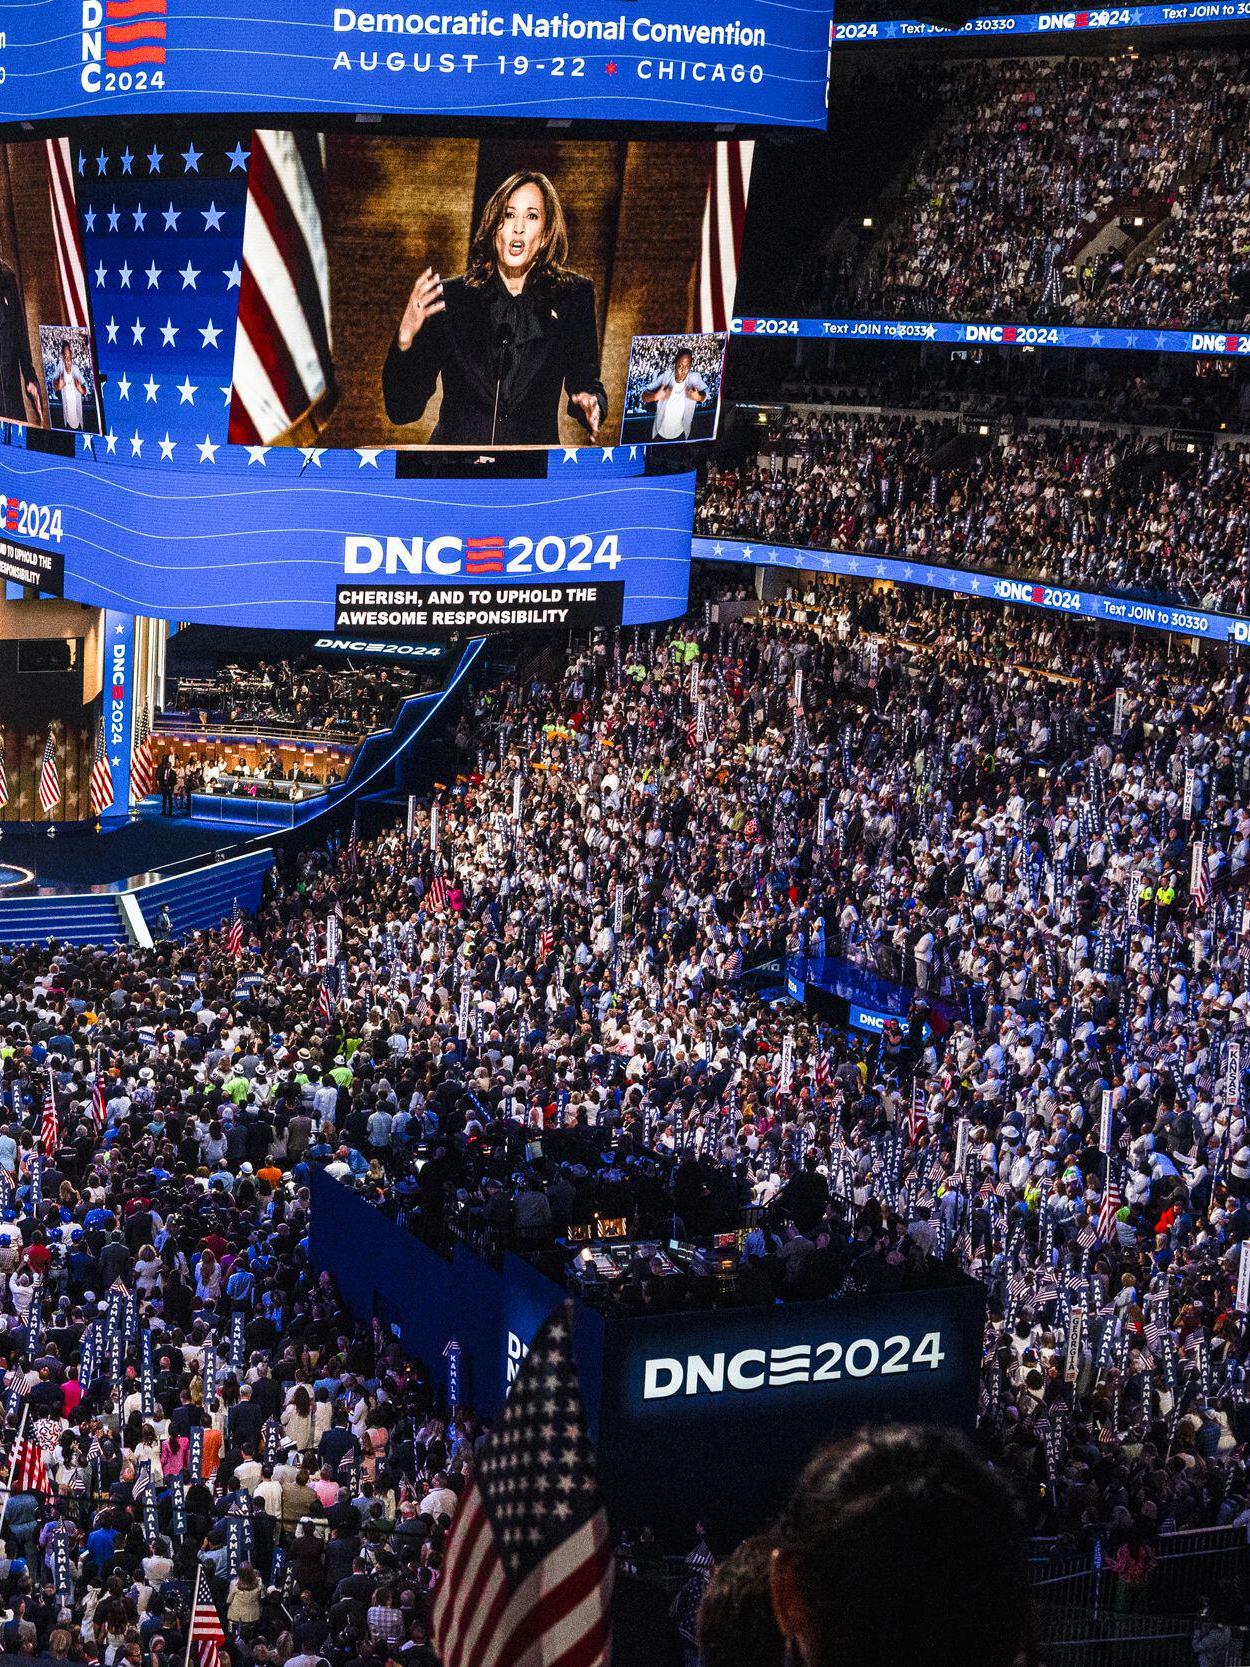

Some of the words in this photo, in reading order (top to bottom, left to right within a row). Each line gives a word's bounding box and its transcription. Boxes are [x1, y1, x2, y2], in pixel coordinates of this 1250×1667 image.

[333, 8, 505, 37] Democratic
[512, 14, 626, 42] National
[633, 18, 766, 47] Convention
[1162, 8, 1187, 20] Text
[1190, 5, 1218, 18] JOIN
[1222, 4, 1234, 16] to
[104, 71, 166, 92] 2024
[333, 51, 479, 74] AUGUST
[497, 55, 586, 78] 19-22
[637, 60, 764, 84] CHICAGO
[823, 323, 849, 335] Text
[851, 324, 881, 336] JOIN
[886, 325, 897, 337] to
[337, 611, 428, 626] AWESOME
[432, 609, 570, 625] RESPONSIBILITY
[338, 590, 423, 608] CHERISH,
[427, 590, 463, 605] AND
[469, 590, 492, 605] TO
[496, 588, 563, 604] UPHOLD
[566, 588, 597, 602] THE
[1103, 600, 1127, 616] Text
[1127, 604, 1155, 622] JOIN
[1158, 609, 1169, 622] to
[1171, 611, 1208, 631] 30330
[1185, 774, 1193, 814] WYOMING
[1129, 877, 1140, 918] NEVADA
[460, 993, 469, 1033] DELAWARE
[1229, 1052, 1237, 1096] KANSAS
[32, 1161, 40, 1200] KAMALA
[28, 1307, 38, 1349] KAMALA
[232, 1317, 241, 1361] KAMALA
[1068, 1317, 1079, 1371] GEORGIA
[206, 1352, 214, 1400] KAMALA
[1143, 1376, 1152, 1421] KAMALA
[192, 1431, 201, 1480] KAMALA
[57, 1538, 67, 1590] KAMALA
